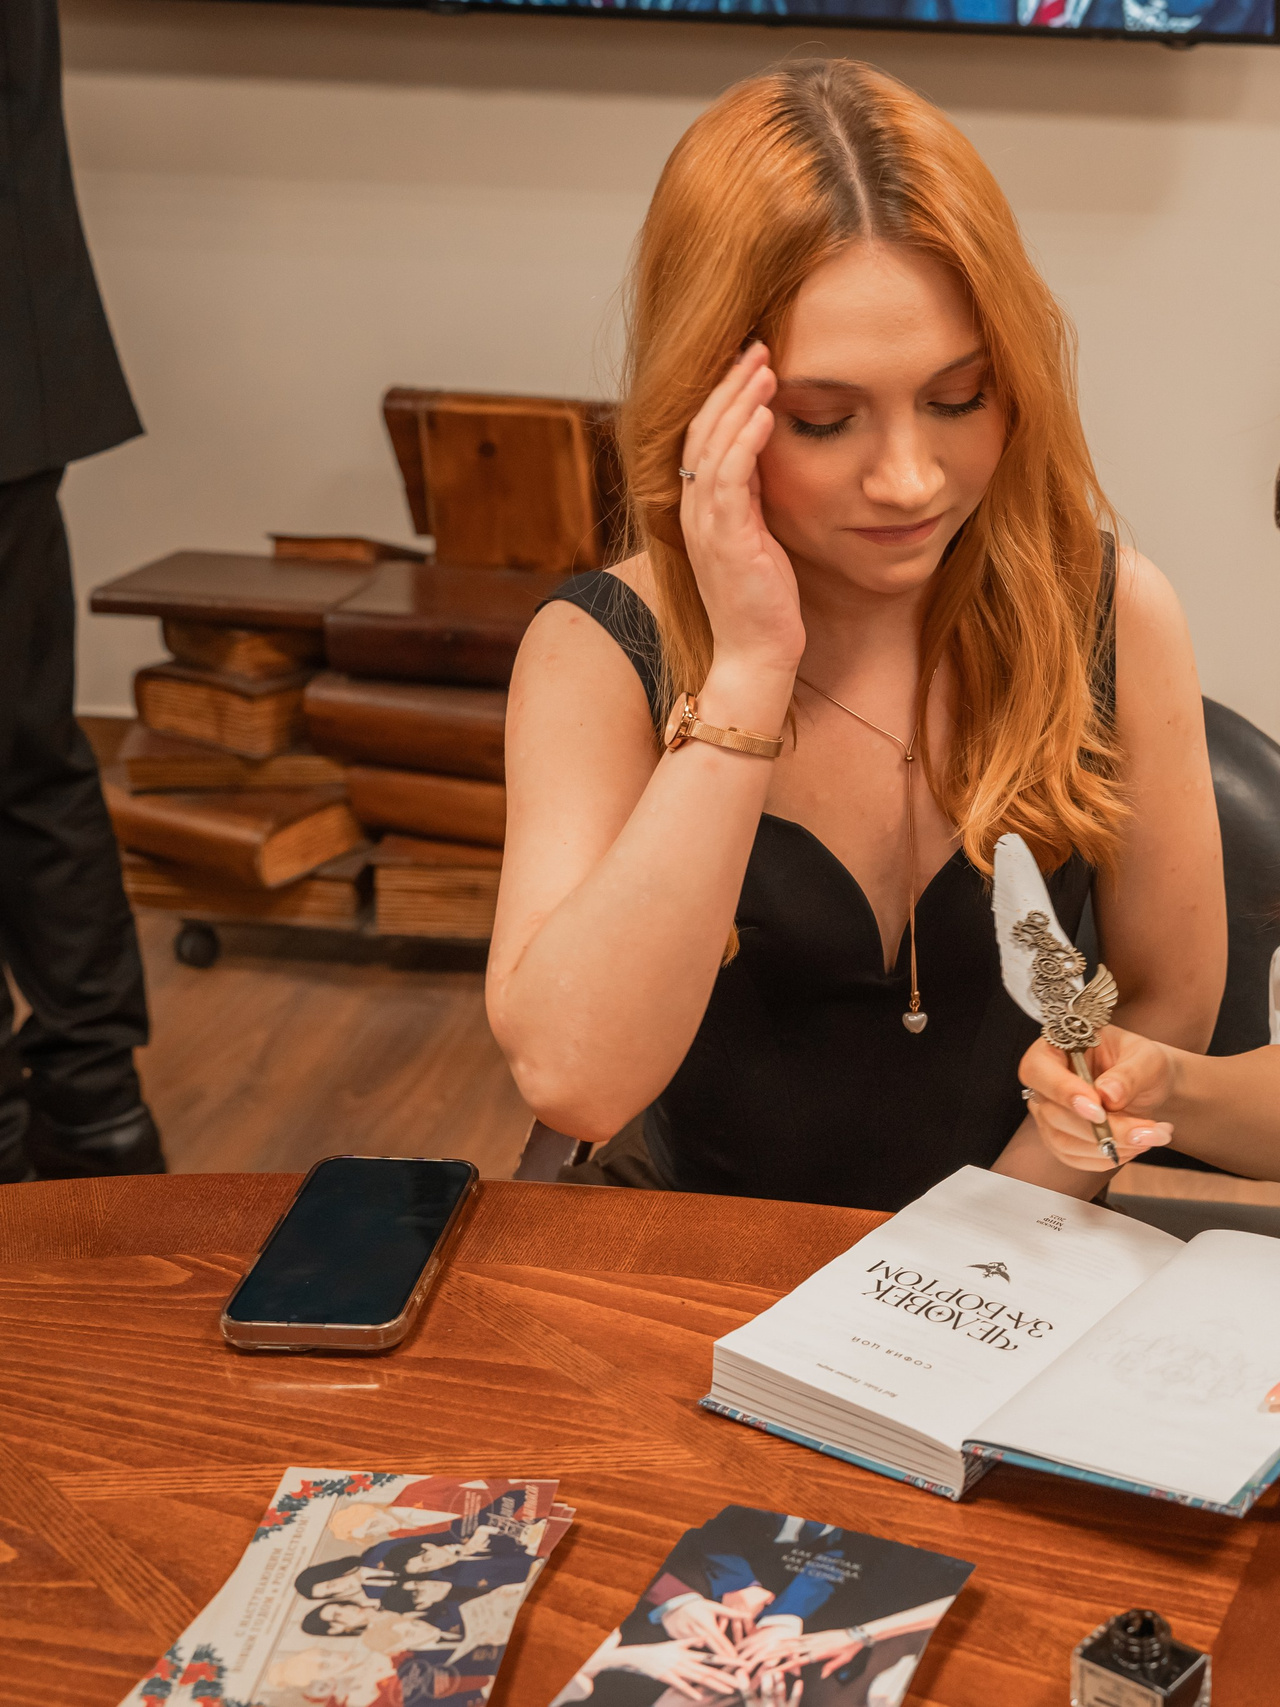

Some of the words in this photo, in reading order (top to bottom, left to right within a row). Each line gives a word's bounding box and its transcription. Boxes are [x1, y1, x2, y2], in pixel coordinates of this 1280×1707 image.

[1036, 1220, 1062, 1231] Москва
[866, 1259, 1008, 1320] БОРТОМ
[861, 1279, 1019, 1350] ЧЕЛОВЕК
[1006, 1311, 1053, 1338] ЗА
[851, 1336, 881, 1349] ЦОЙ
[885, 1348, 933, 1369] СОФИЯ
